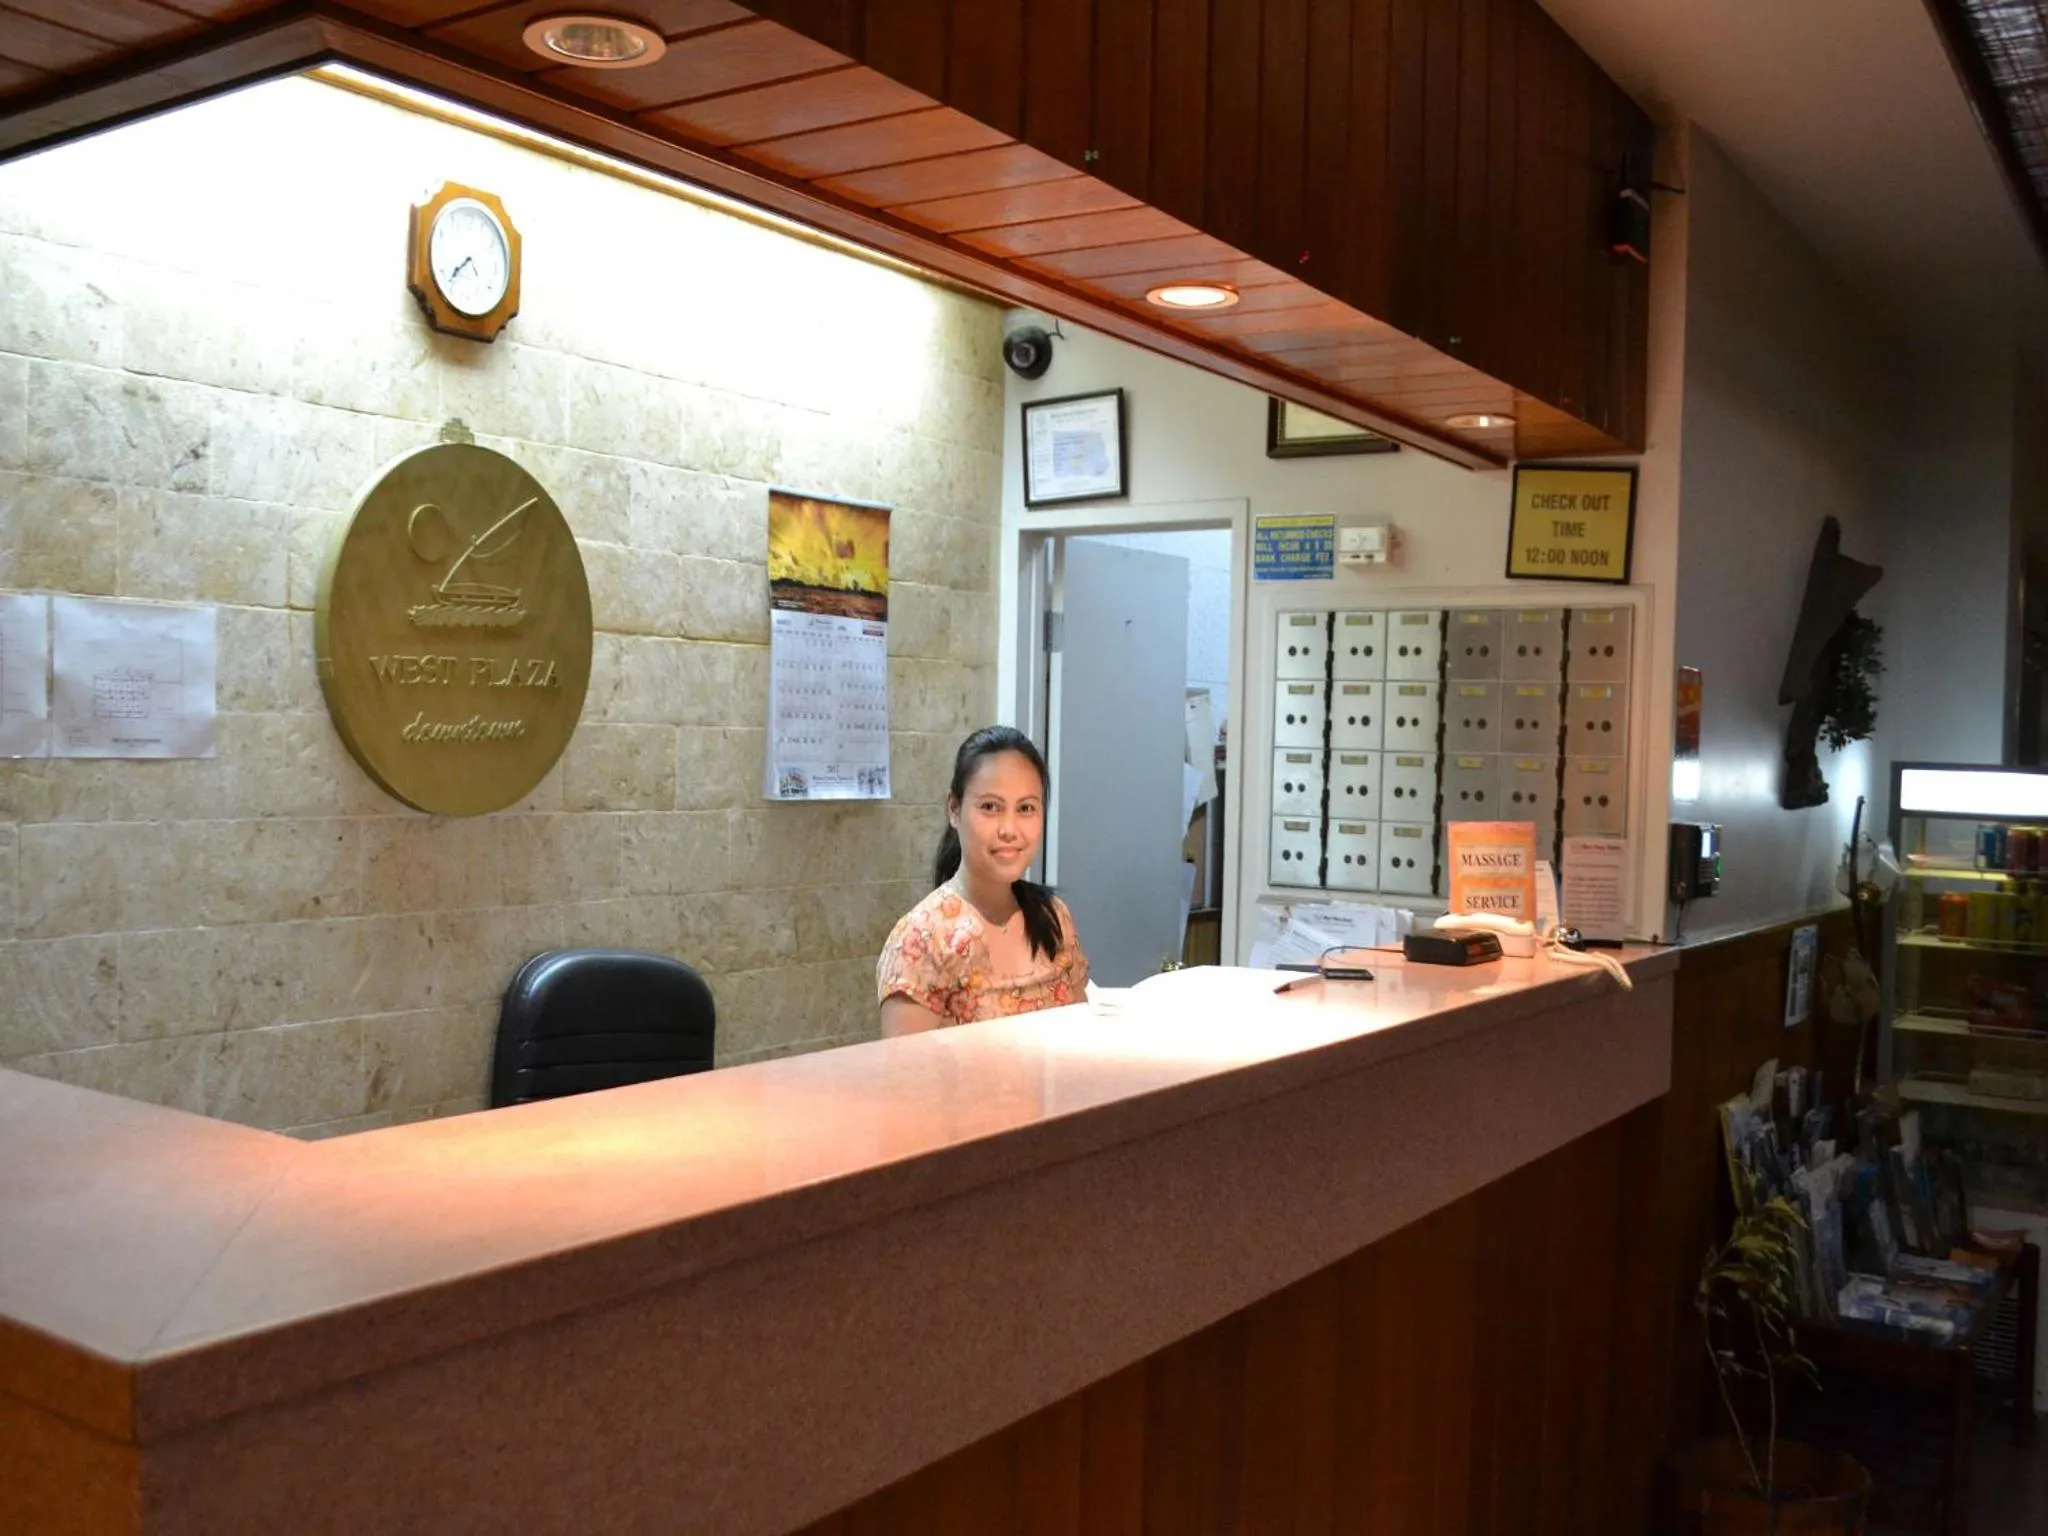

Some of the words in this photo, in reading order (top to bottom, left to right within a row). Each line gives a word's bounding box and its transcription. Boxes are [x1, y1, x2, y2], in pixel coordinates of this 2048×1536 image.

[1531, 493, 1577, 510] CHECK
[1581, 494, 1611, 511] OUT
[1552, 520, 1586, 538] TIME
[1525, 548, 1566, 565] 12:00
[1570, 549, 1611, 566] NOON
[368, 655, 457, 685] WEST
[468, 658, 559, 688] PLAZA
[402, 711, 524, 741] downtown
[1461, 853, 1521, 868] MASSAGE
[1466, 895, 1520, 910] SERVICE
